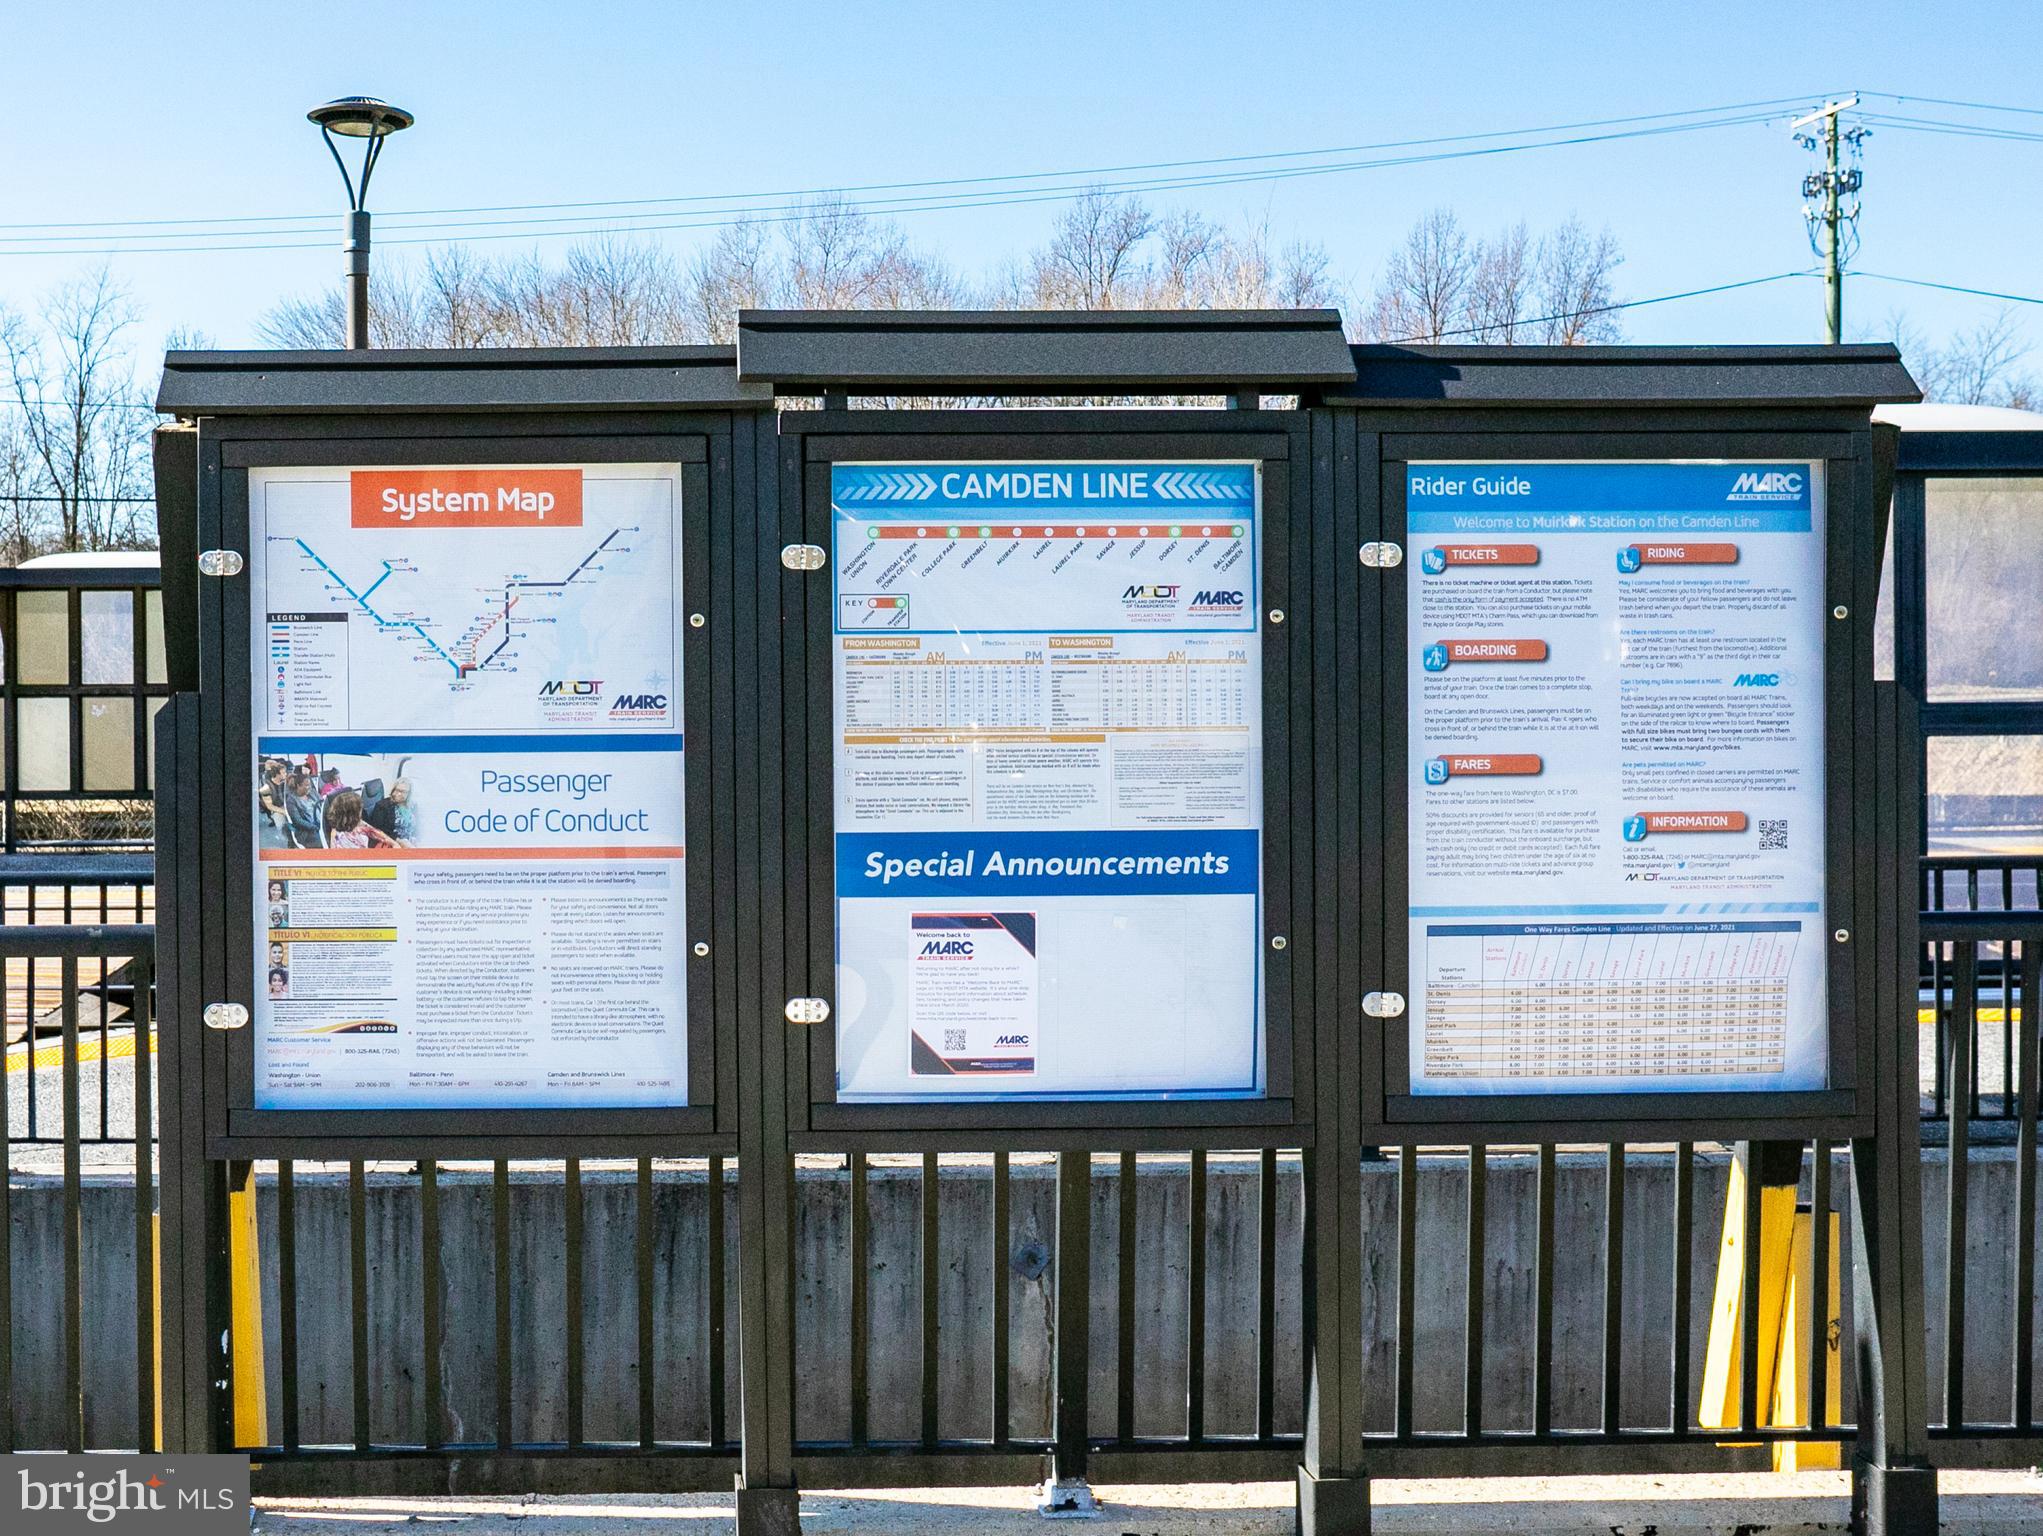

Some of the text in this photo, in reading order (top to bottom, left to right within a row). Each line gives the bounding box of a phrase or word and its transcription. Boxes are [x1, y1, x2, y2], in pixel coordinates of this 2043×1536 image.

[941, 473, 1149, 500] CAMDEN LINE
[1411, 476, 1531, 496] Rider Guide
[1731, 472, 1802, 492] MARC
[382, 487, 555, 520] System Map
[1453, 515, 1759, 528] Welcome to Muirkk Station on the Camden Line
[842, 541, 876, 576] WASHINGTON
[921, 541, 957, 578] COLLEGE PARK
[961, 540, 989, 569] GREENBELT
[996, 540, 1021, 567] MUIRKIRK
[1032, 539, 1052, 560] LAUREL
[1051, 540, 1085, 575] LAUREL PARK
[1096, 540, 1116, 561] SAVAGE
[1128, 539, 1147, 560] JESSUP
[1158, 540, 1179, 562] DORSEY
[1187, 539, 1210, 564] ST. DENIS
[1213, 539, 1242, 570] BALTIMORE
[1452, 548, 1498, 560] TICKETS
[1647, 547, 1685, 559] RIDING
[850, 560, 868, 579] UNION
[875, 542, 918, 585] RIVERDALE PARK
[1221, 548, 1244, 573] CAMDEN
[881, 573, 897, 591] TOWN
[1192, 591, 1244, 605] MARC
[867, 639, 917, 647] WASHINGTON
[1454, 644, 1517, 657] BOARDING
[926, 652, 945, 663] AM
[1025, 651, 1042, 660] PM
[1167, 651, 1186, 662] AM
[1228, 651, 1246, 660] PM
[1733, 673, 1780, 687] MARC
[612, 695, 667, 709] MARC
[1454, 759, 1491, 770] FARES
[480, 769, 612, 800] Passenger
[445, 808, 649, 833] Code of Conduct
[1652, 816, 1728, 827] INFORMATION
[864, 850, 1230, 884] Special Announcements
[1539, 926, 1553, 934] Way
[1616, 925, 1642, 934] Updated
[1657, 924, 1684, 932] Effective
[1709, 924, 1720, 932] 27,
[921, 941, 974, 955] MARC
[996, 1035, 1029, 1044] MARC
